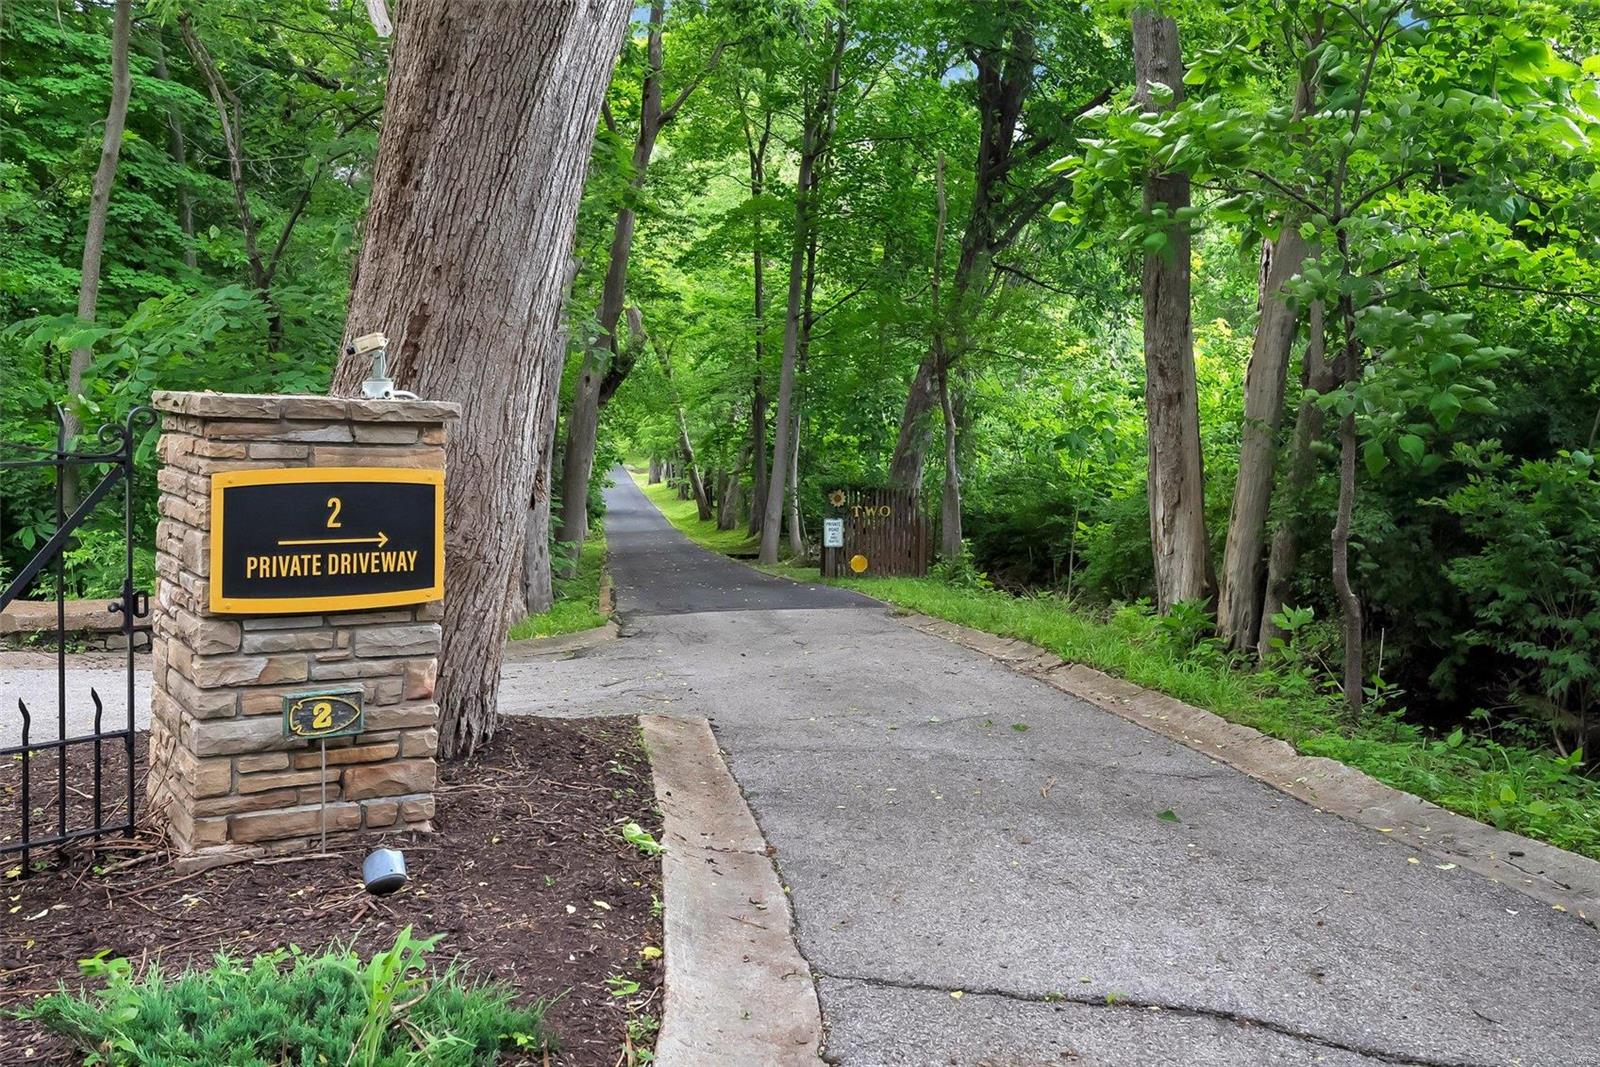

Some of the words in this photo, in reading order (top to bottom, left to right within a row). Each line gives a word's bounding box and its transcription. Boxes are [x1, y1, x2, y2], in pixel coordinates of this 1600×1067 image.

[326, 497, 342, 528] 2
[851, 505, 891, 517] TWO
[247, 555, 321, 578] PRIVATE
[328, 551, 417, 575] DRIVEWAY
[312, 702, 332, 729] 2
